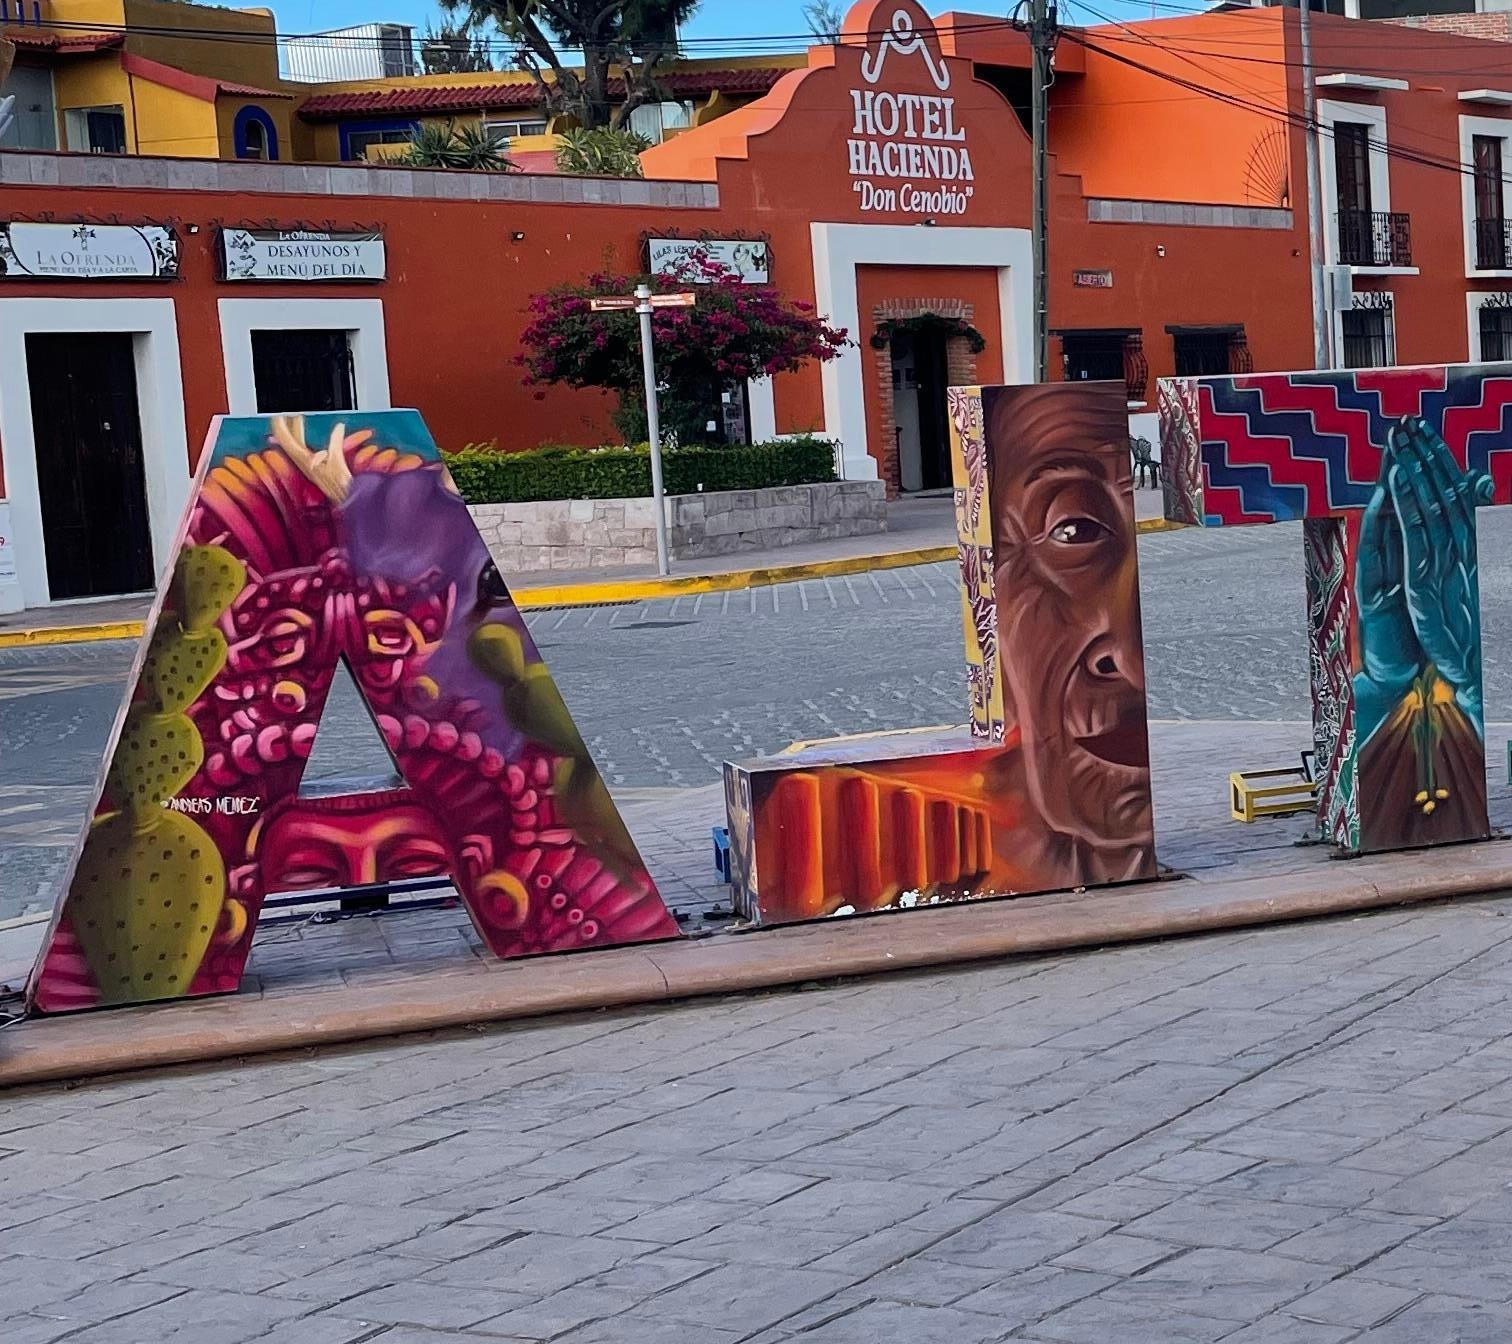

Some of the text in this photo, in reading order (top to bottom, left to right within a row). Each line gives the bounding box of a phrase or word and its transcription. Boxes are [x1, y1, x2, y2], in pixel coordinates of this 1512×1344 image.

[850, 89, 966, 142] HOTEL
[847, 139, 974, 181] HACIENDA
[268, 245, 362, 258] DESAYUNOS Y
[267, 260, 366, 277] MENÚ DEL DÍA
